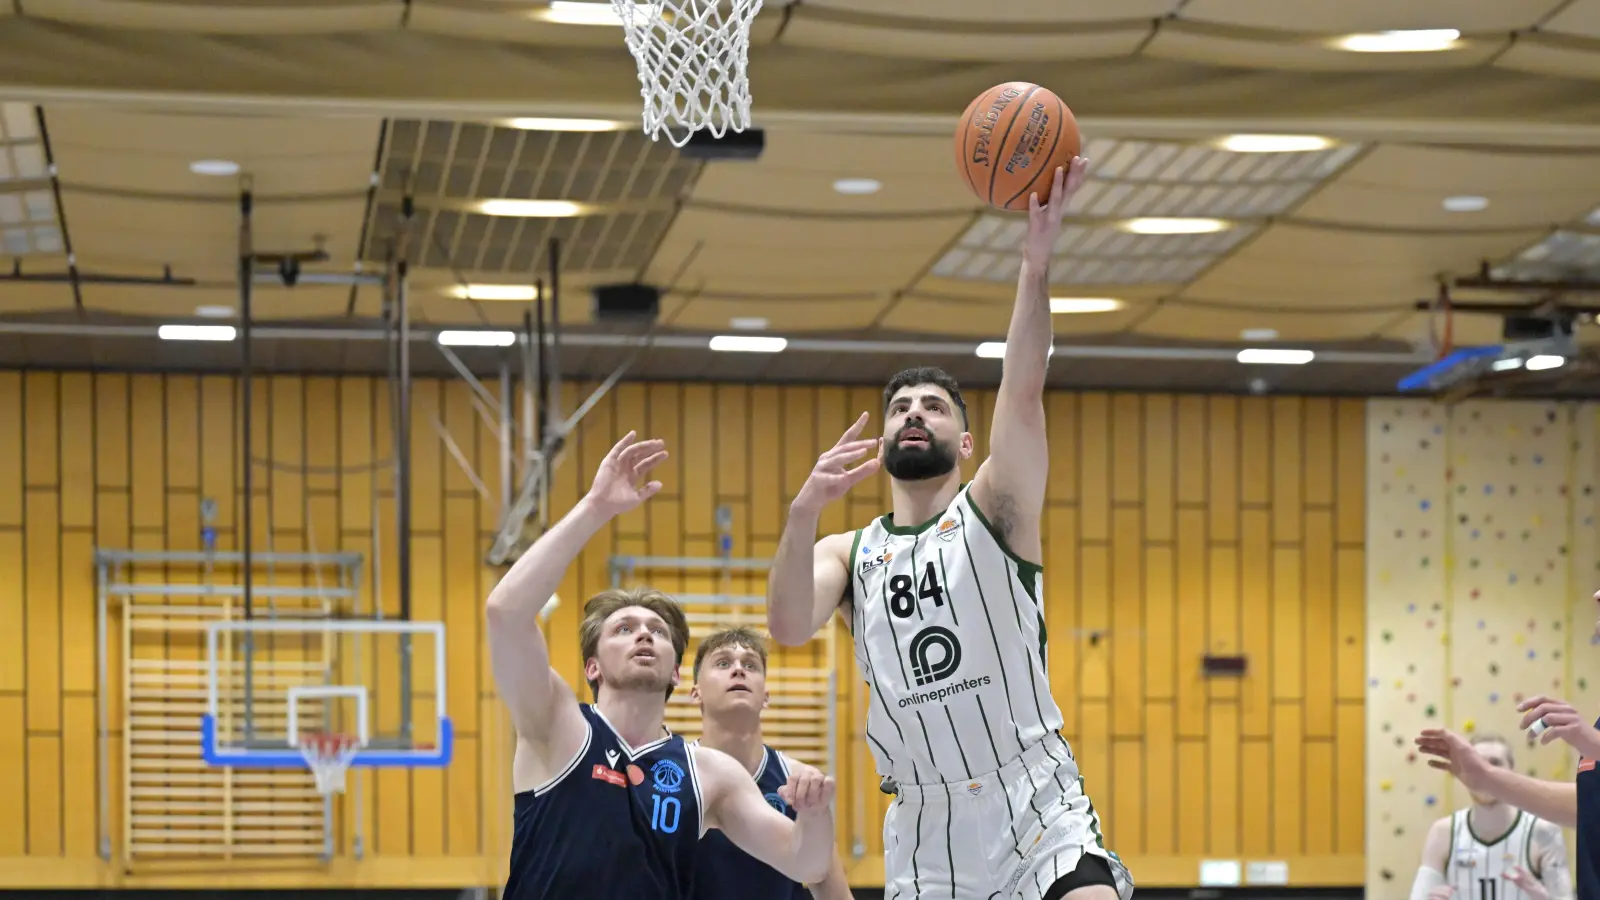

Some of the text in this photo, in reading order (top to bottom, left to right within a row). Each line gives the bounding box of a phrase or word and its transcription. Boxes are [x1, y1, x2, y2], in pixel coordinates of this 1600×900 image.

[973, 88, 1023, 167] SPALDING
[1005, 102, 1045, 174] PRECISION
[889, 561, 944, 619] 84
[898, 675, 991, 708] onlineprinters
[651, 794, 681, 834] 10
[1478, 878, 1496, 900] 11
